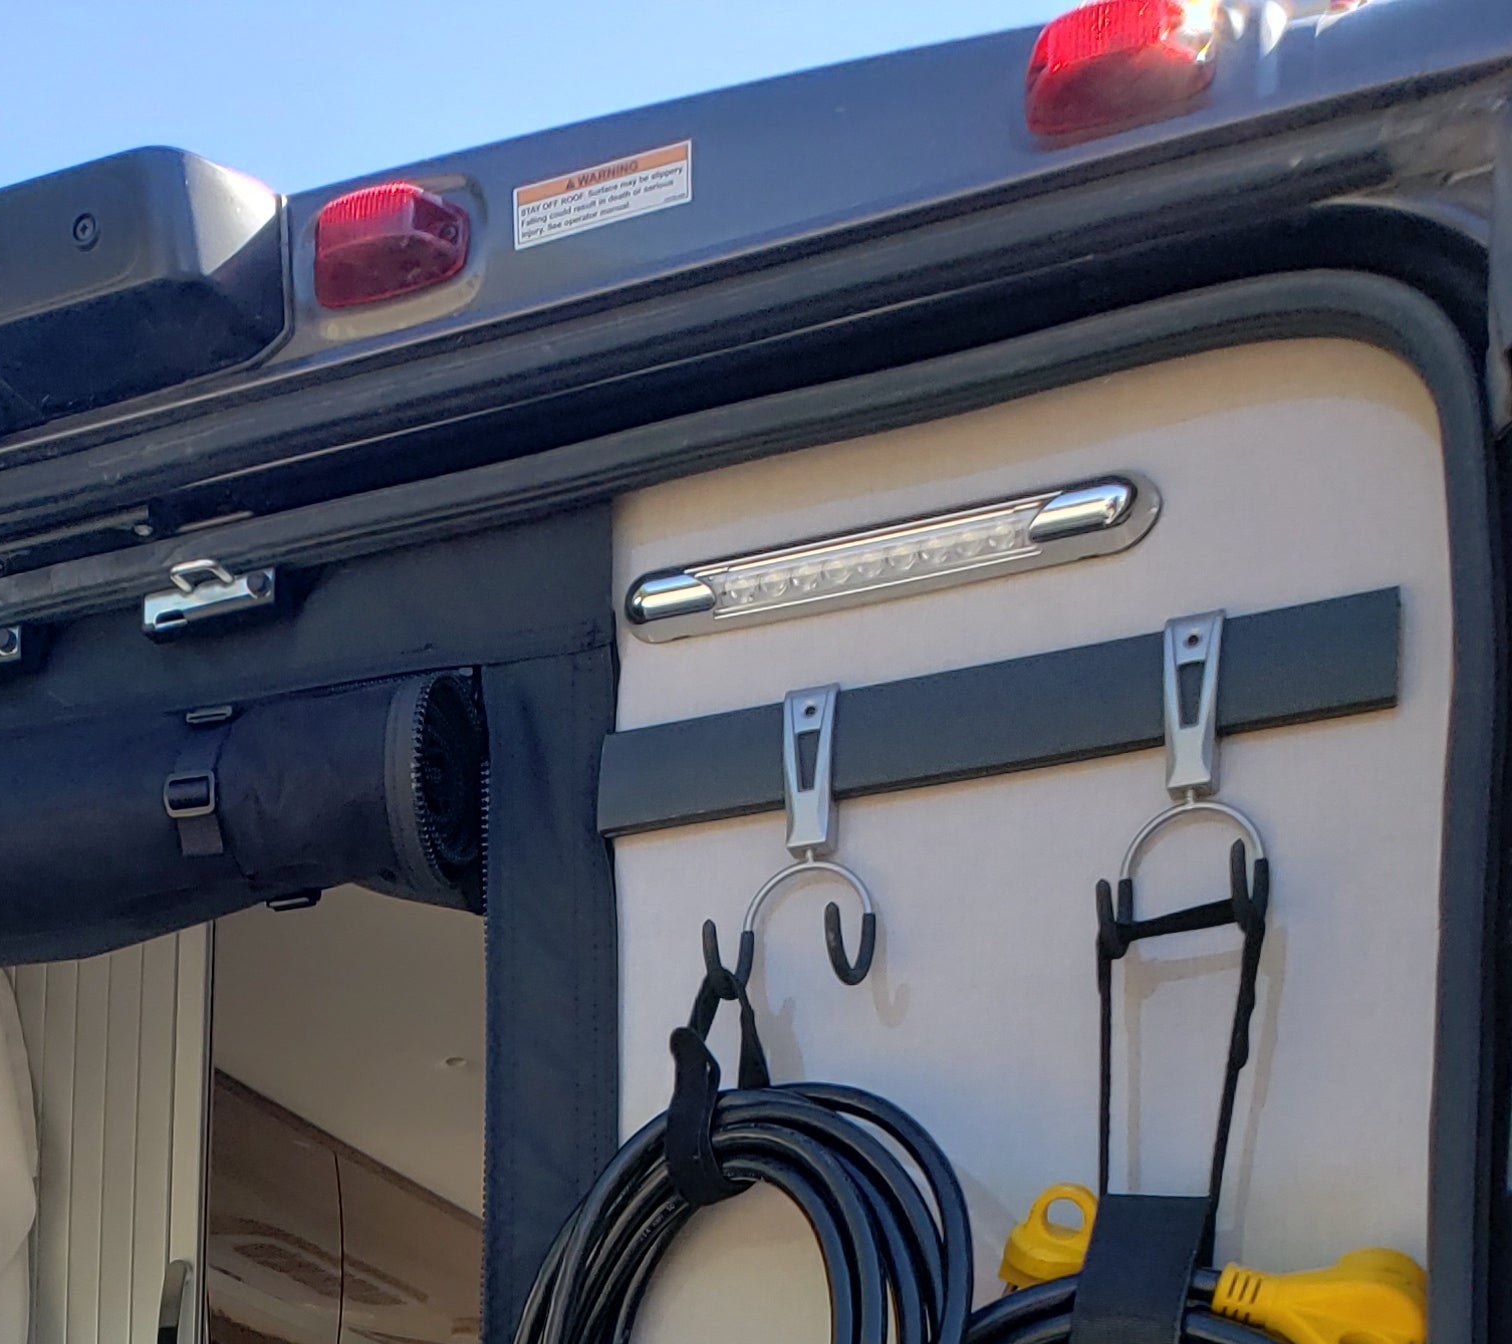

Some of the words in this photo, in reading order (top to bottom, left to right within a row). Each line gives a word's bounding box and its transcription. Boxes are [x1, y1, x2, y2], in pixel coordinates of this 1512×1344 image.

[521, 205, 540, 217] STAY
[542, 199, 558, 211] OFF
[620, 178, 637, 188] may
[639, 174, 650, 183] be
[651, 167, 682, 180] slippery
[578, 161, 638, 187] WARNING
[521, 215, 547, 228] Falling
[549, 207, 572, 219] could
[573, 200, 597, 212] result
[598, 197, 606, 206] in
[608, 191, 631, 202] death
[633, 187, 642, 196] or
[644, 180, 674, 193] serious
